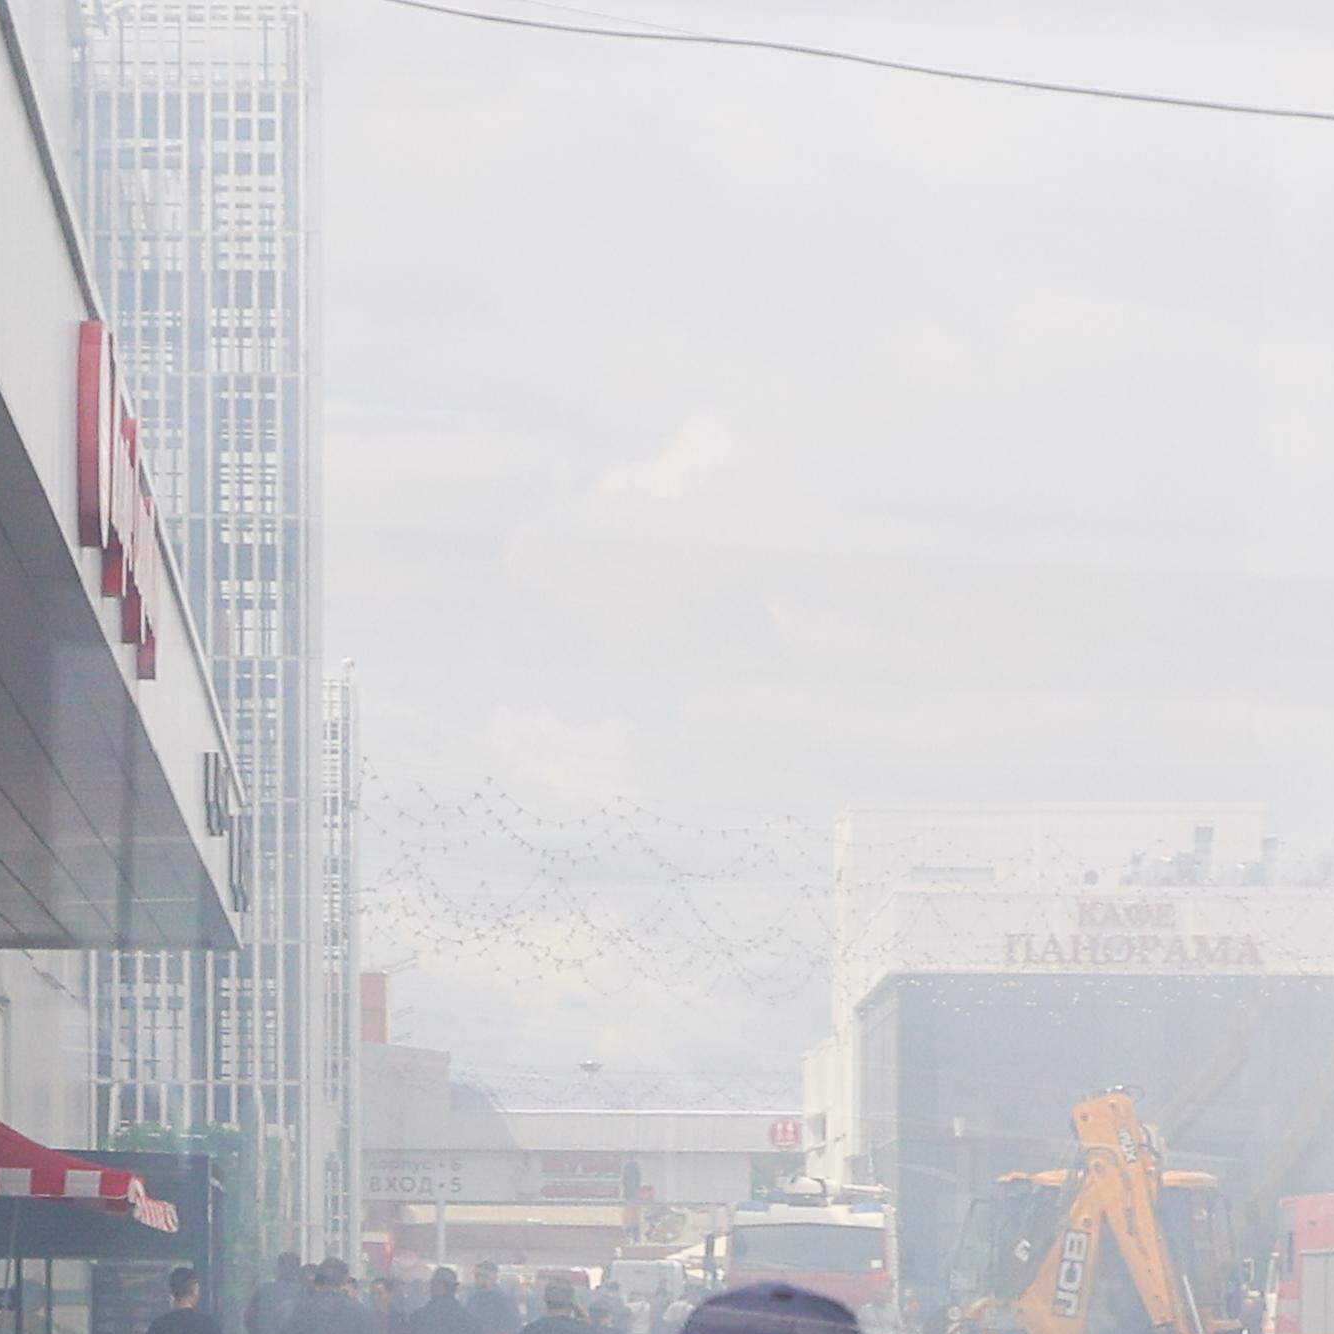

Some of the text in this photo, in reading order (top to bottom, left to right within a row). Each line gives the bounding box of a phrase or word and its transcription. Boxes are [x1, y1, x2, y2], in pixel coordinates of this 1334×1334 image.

[1077, 901, 1176, 928] КАФЕ
[1004, 933, 1266, 965] ПАНОРАМА
[369, 1176, 435, 1195] ВХОД
[1056, 1230, 1090, 1317] JCB
